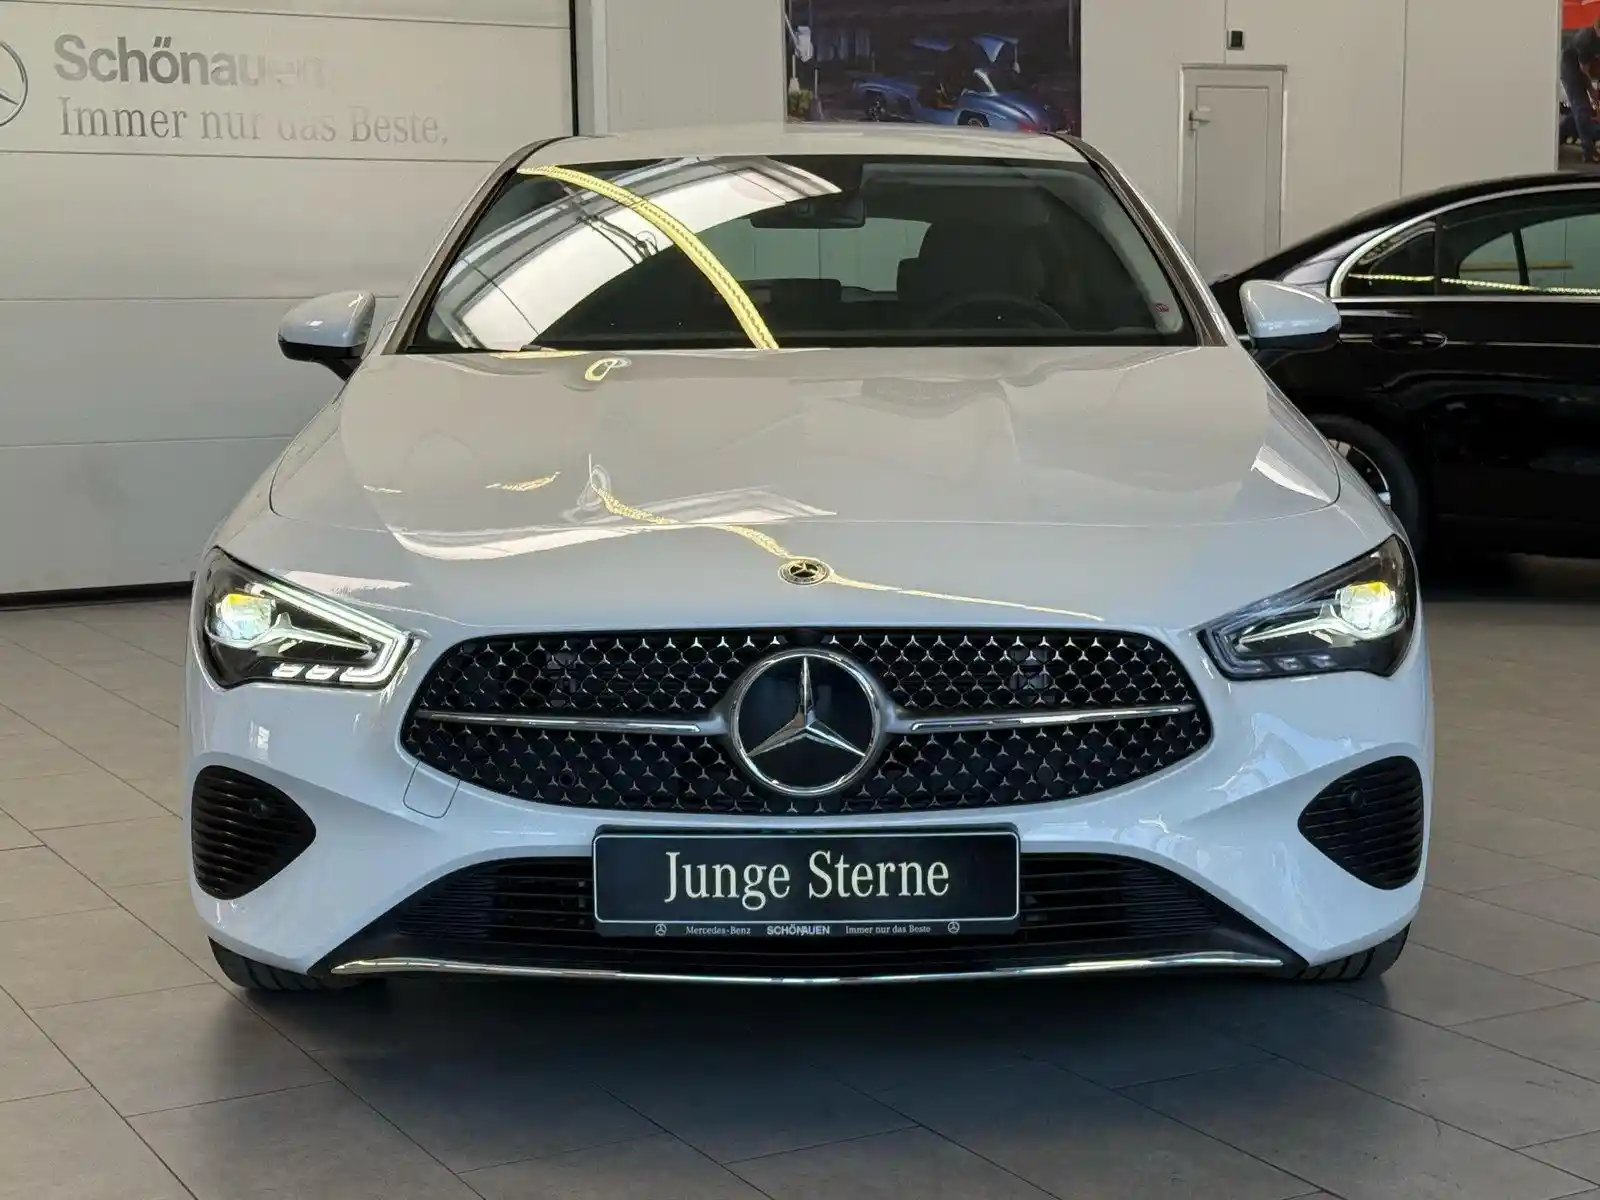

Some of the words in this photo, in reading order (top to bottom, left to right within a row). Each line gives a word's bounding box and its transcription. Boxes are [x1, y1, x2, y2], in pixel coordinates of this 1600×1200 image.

[57, 97, 188, 139] Immer
[201, 110, 261, 140] nur
[664, 851, 790, 910] Junge
[809, 850, 949, 899] Sterne
[686, 925, 751, 935] Mercedes-Benz
[766, 924, 830, 936] SCHÖNAUEN
[845, 926, 873, 934] Immer
[875, 926, 891, 934] nur
[892, 924, 907, 933] das
[909, 924, 931, 933] Beste
